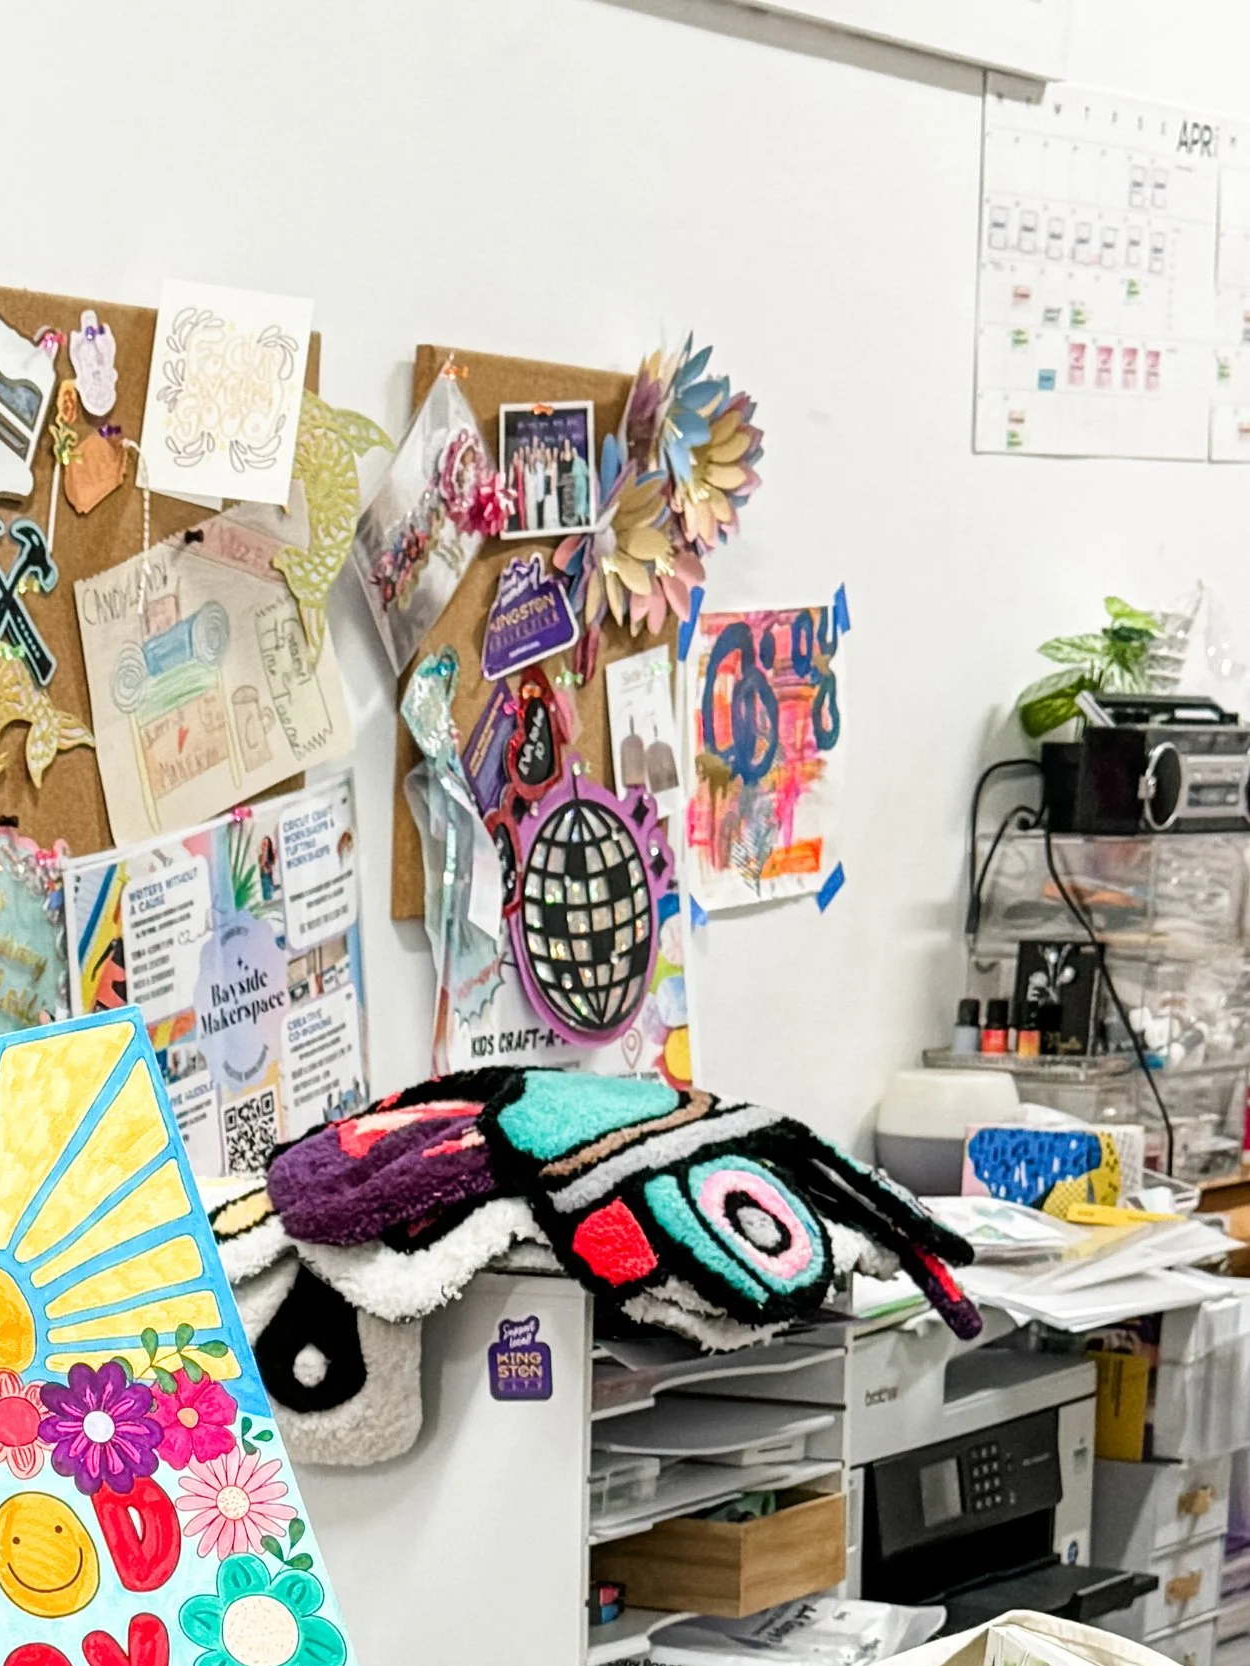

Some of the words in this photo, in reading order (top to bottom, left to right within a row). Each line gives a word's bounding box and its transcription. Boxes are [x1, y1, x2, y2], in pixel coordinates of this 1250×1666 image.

[211, 968, 268, 1007] Bayside
[201, 990, 285, 1039] Makerspace
[471, 1034, 495, 1058] KIDS
[496, 1351, 542, 1365] KING
[497, 1364, 543, 1378] STON
